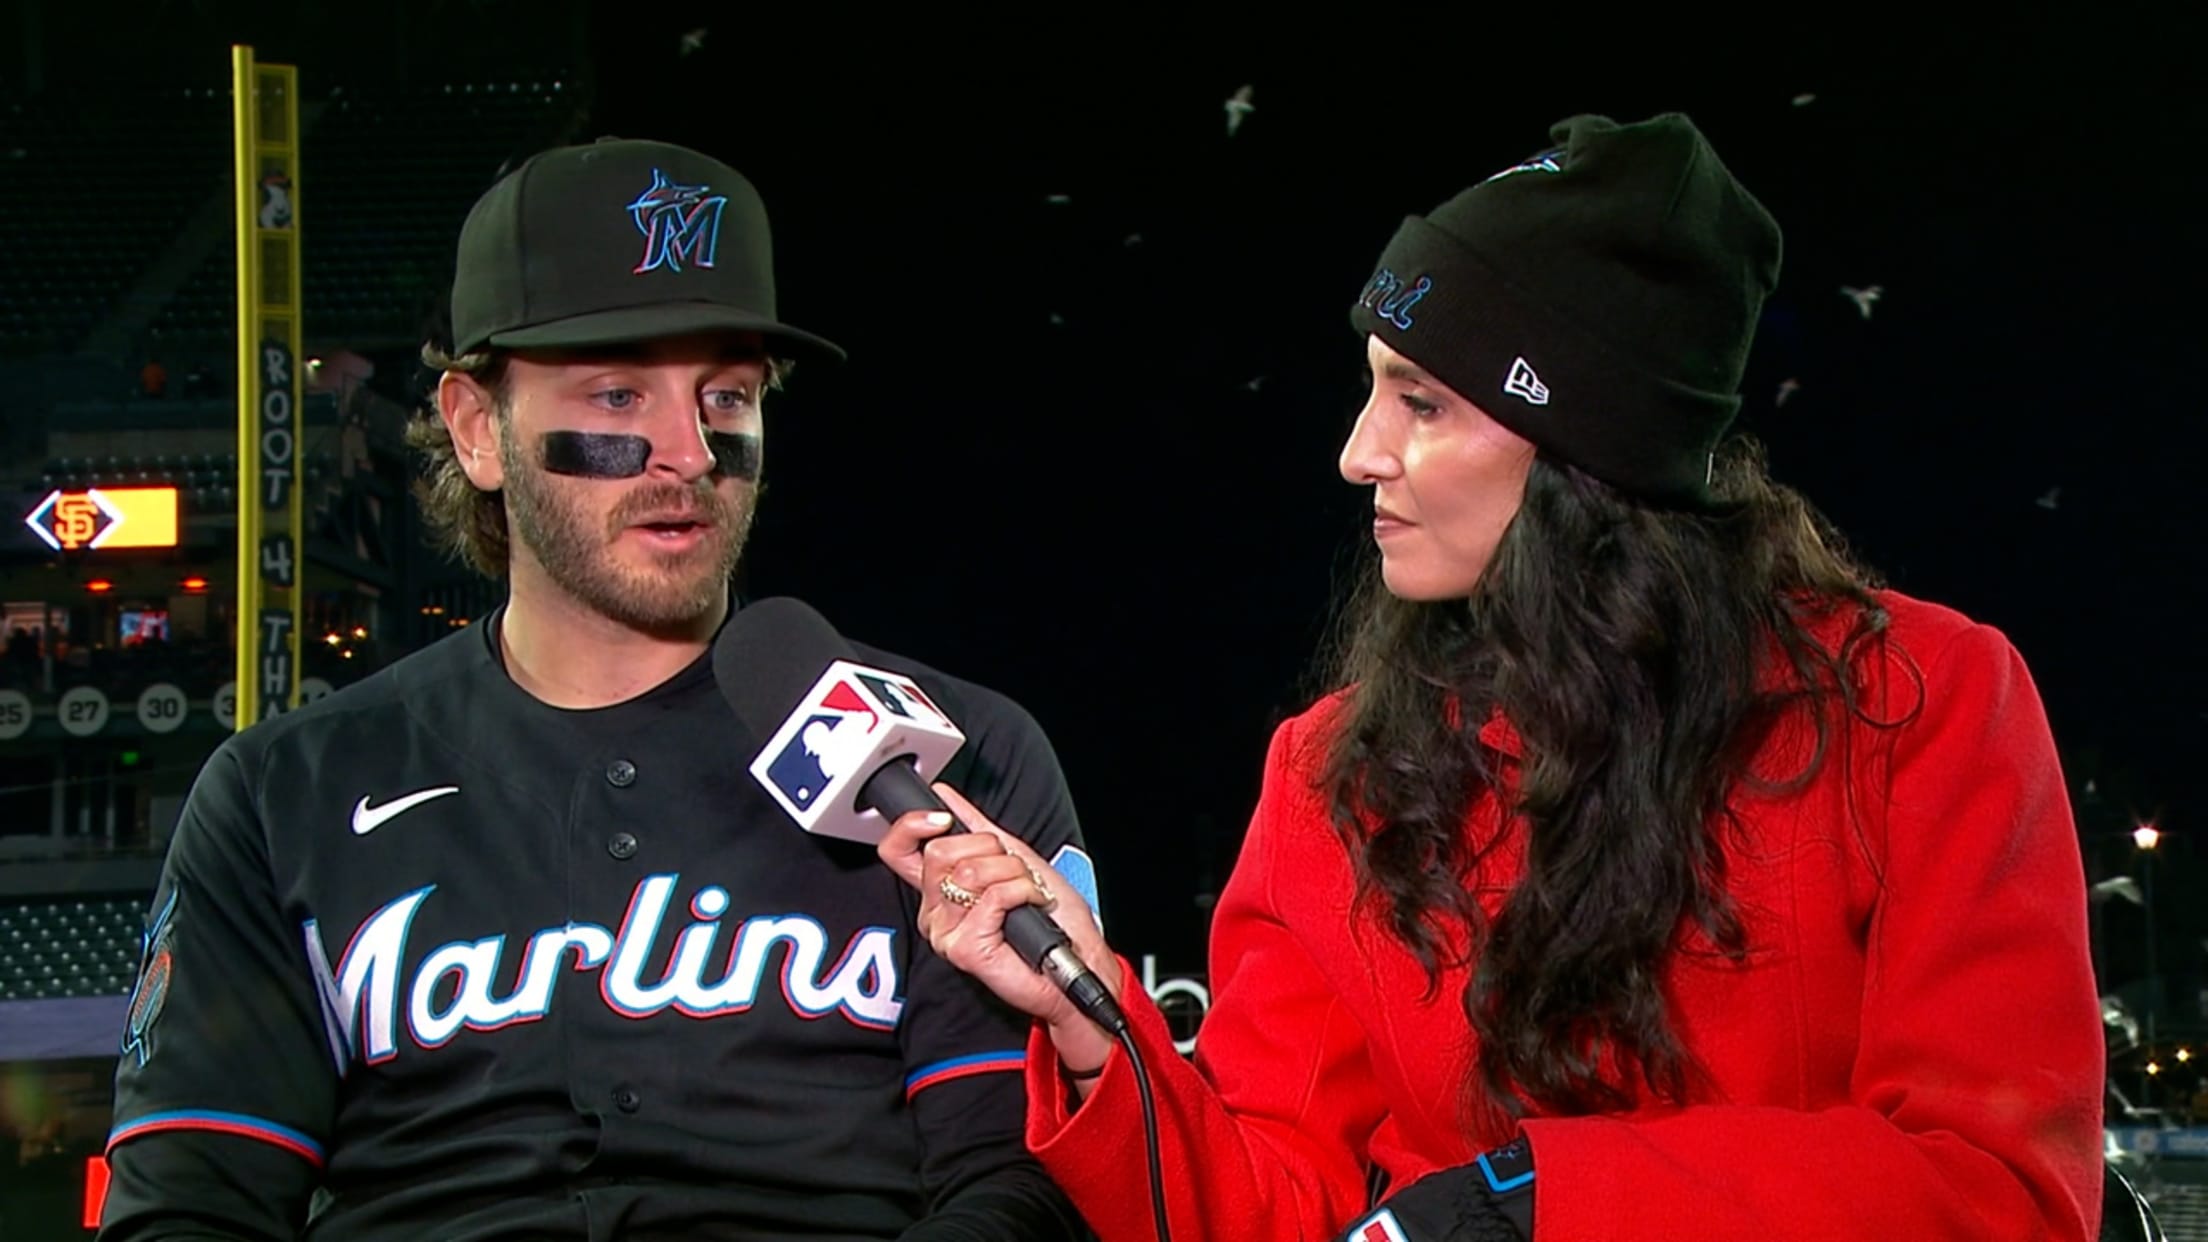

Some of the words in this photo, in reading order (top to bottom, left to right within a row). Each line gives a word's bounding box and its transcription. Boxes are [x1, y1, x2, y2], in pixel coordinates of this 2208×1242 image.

[263, 348, 292, 503] ROOT
[54, 494, 98, 549] SF
[263, 541, 292, 581] 4
[69, 701, 99, 723] 27
[147, 698, 179, 719] 30
[303, 872, 906, 1079] Marlins
